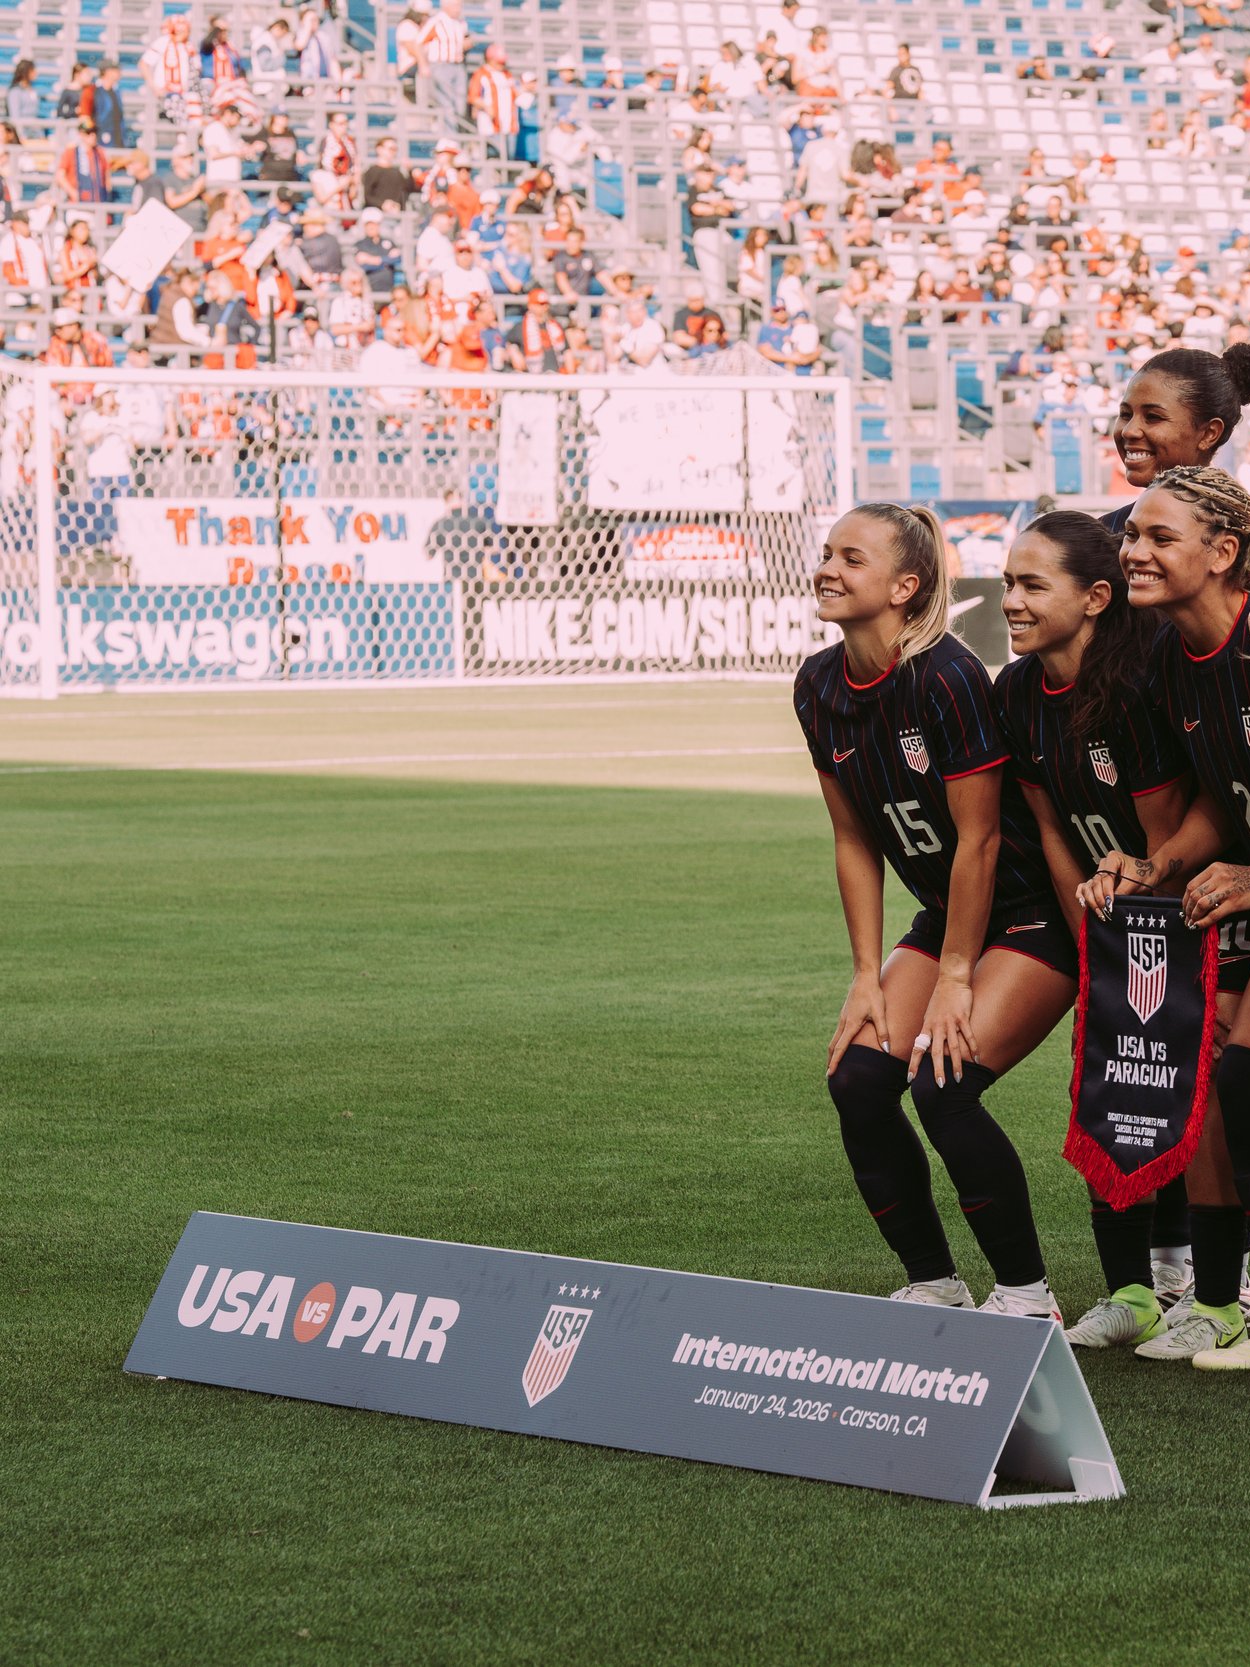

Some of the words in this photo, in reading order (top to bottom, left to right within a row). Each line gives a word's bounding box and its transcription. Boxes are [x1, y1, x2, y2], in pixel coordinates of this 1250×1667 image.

[166, 505, 310, 546] Thank
[323, 504, 408, 544] You
[0, 601, 347, 680] okswagen
[883, 799, 943, 857] 15
[1070, 813, 1126, 865] 10
[1130, 936, 1165, 973] USA
[1117, 1034, 1146, 1060] USA
[1150, 1041, 1167, 1062] VS
[1104, 1060, 1179, 1089] PARAGUAY
[177, 1264, 296, 1340] USA
[326, 1285, 461, 1364] PAR
[543, 1310, 589, 1350] USA
[672, 1332, 886, 1391] International
[880, 1361, 990, 1407] Match
[694, 1385, 765, 1415] January
[762, 1395, 787, 1419] 24,
[788, 1398, 832, 1422] 2026
[839, 1405, 901, 1436] Carson,
[904, 1415, 929, 1438] CA
